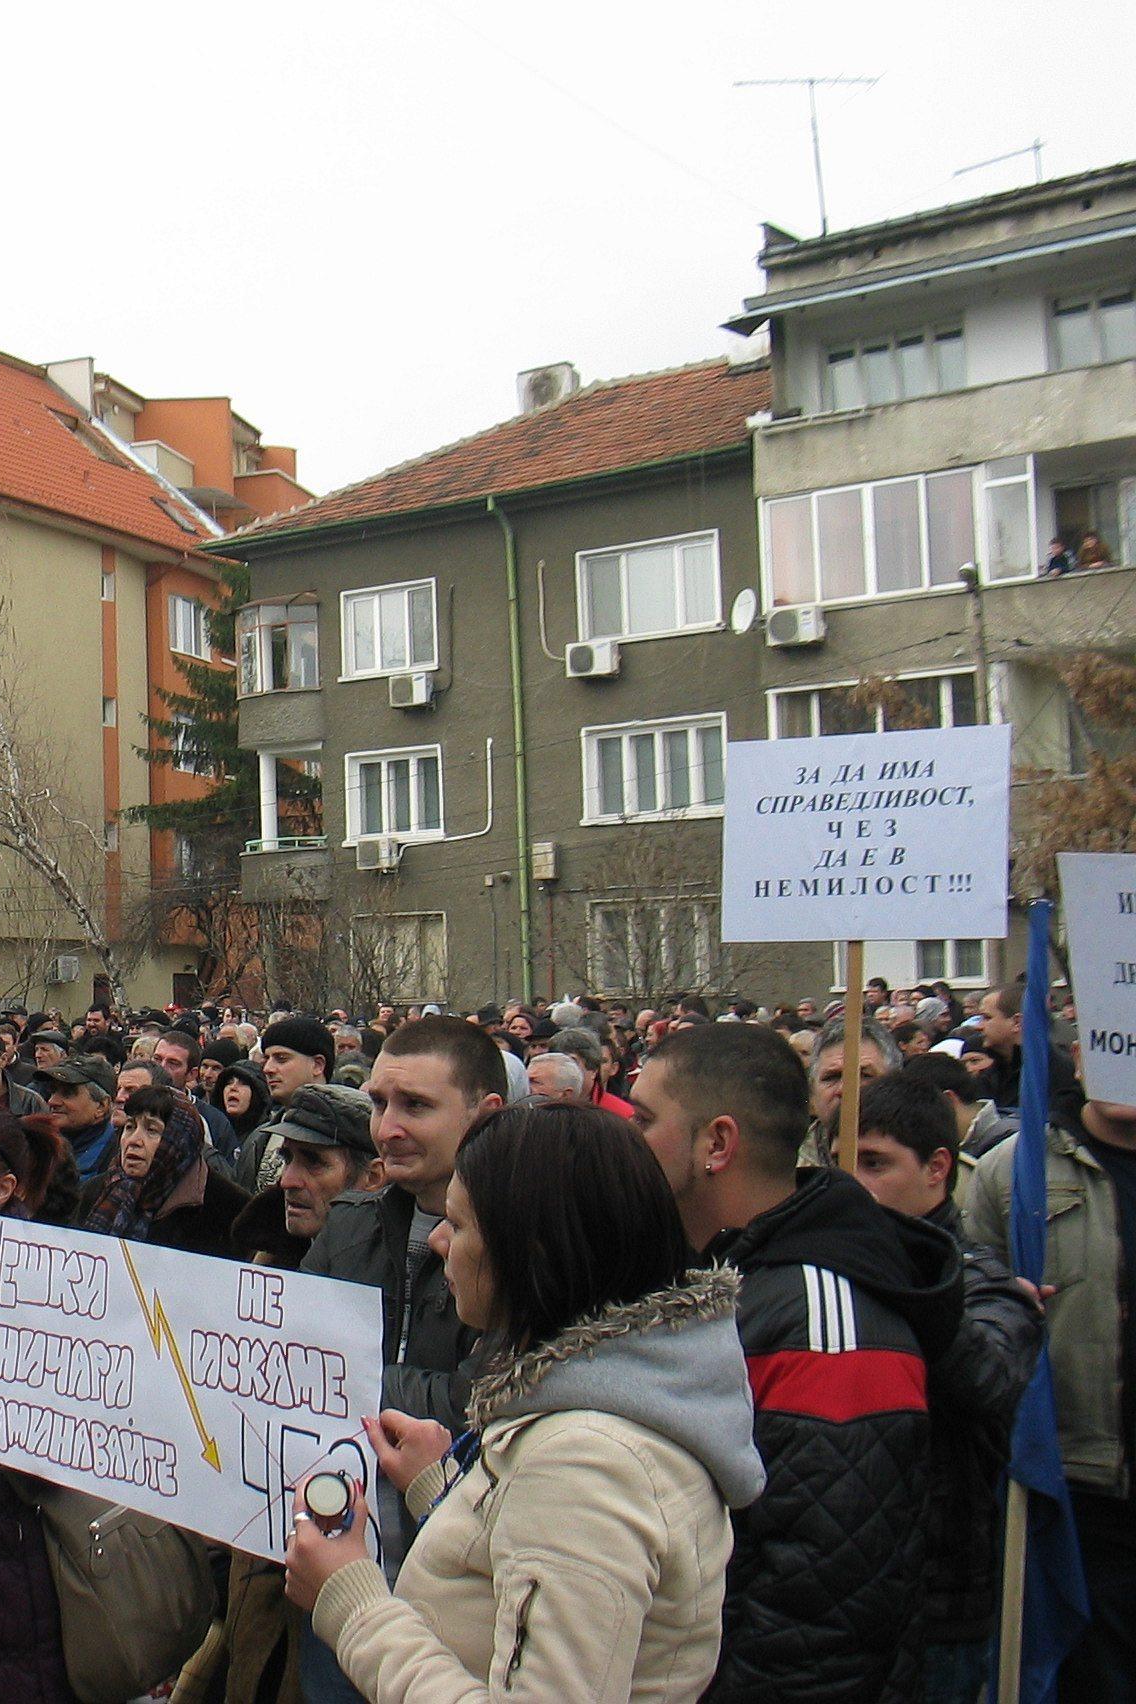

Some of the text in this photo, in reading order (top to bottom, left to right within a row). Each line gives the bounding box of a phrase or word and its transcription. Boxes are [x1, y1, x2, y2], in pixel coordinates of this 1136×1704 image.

[794, 759, 936, 786] ЗА ДА ИМА
[756, 785, 976, 815] СПРАВЕДЛИВОСТ,
[813, 849, 848, 872] ДА
[754, 873, 973, 899] НЕМИЛОСТ!!!
[237, 1267, 284, 1329] НЕ
[190, 1329, 349, 1419] ИСКАМЕ
